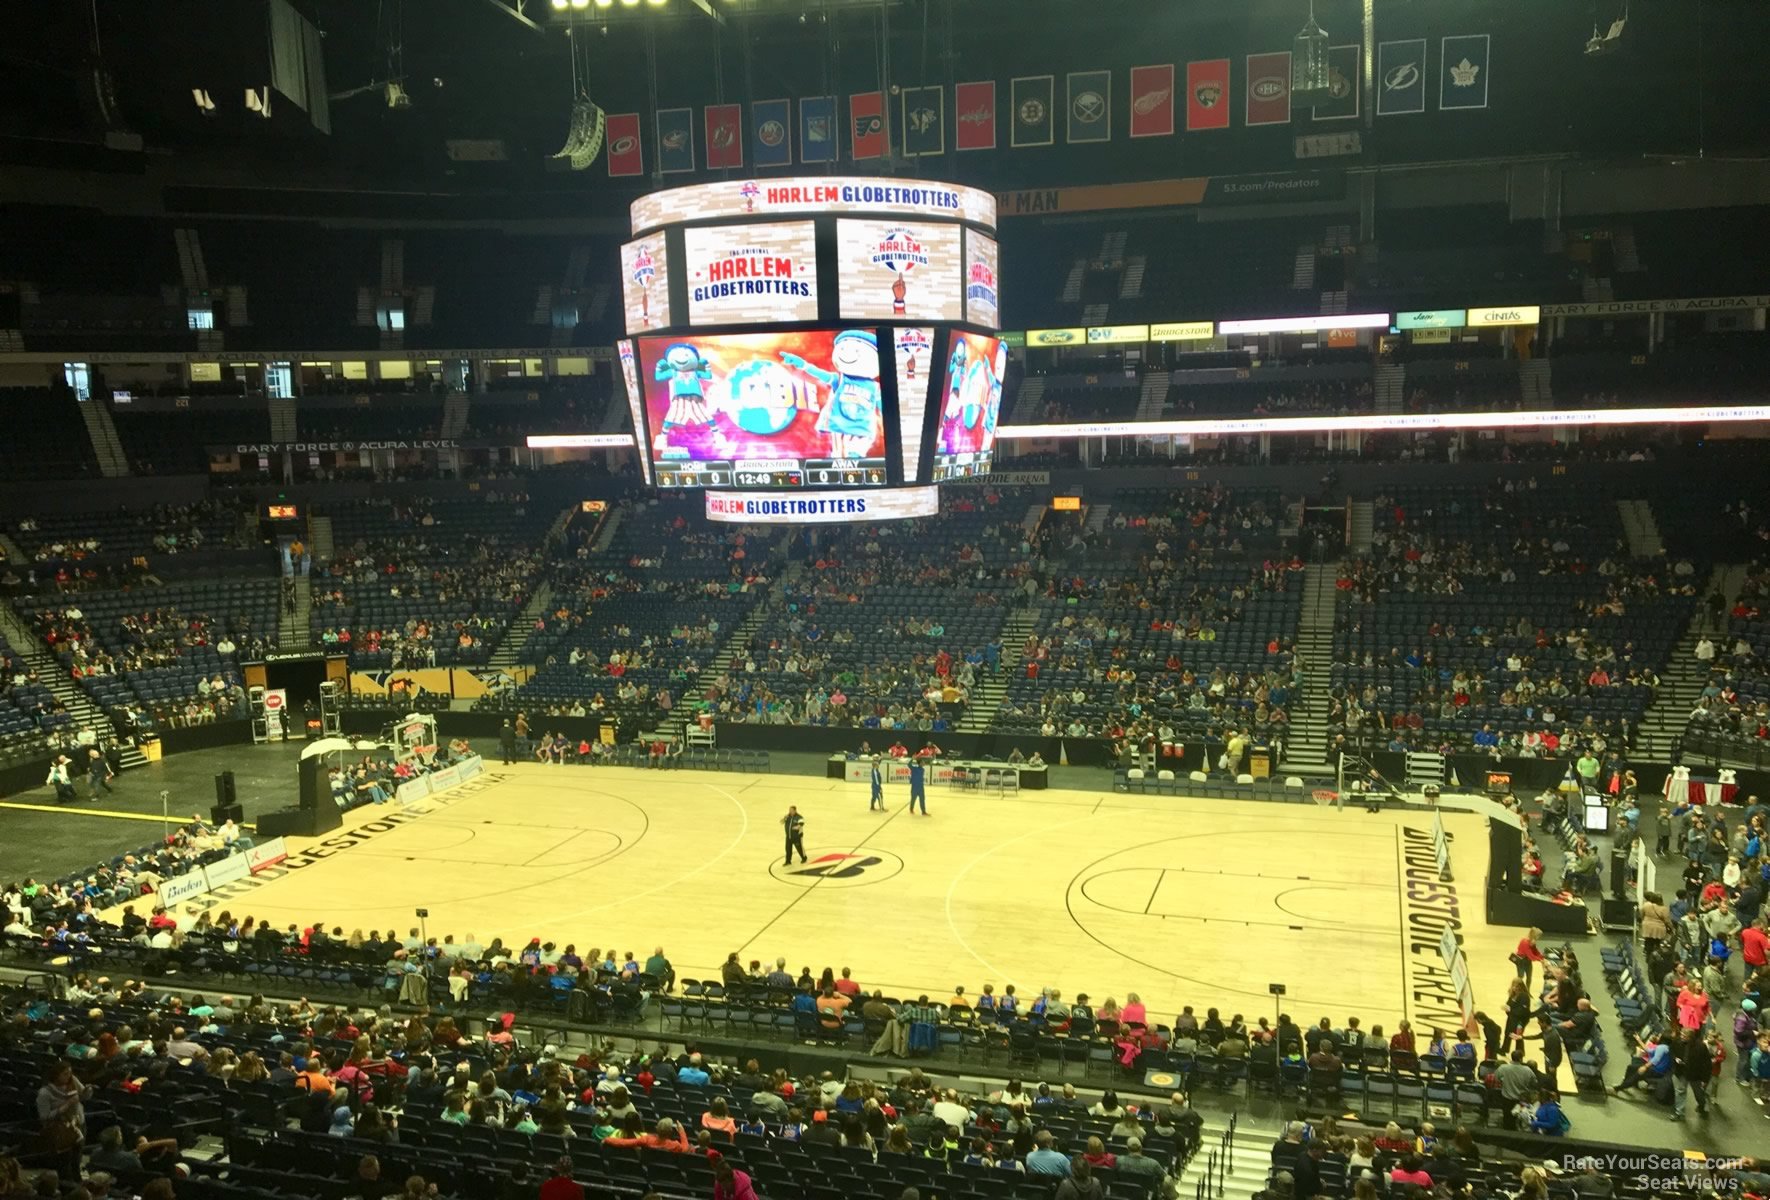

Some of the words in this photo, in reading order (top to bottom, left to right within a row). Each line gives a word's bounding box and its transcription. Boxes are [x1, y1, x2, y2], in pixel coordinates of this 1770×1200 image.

[767, 186, 839, 204] HARLEM
[842, 186, 959, 208] GLOBETROTTERS
[1016, 191, 1059, 213] MAN
[880, 241, 920, 253] HARLEM
[873, 253, 928, 265] GLOBETROTTERS
[708, 257, 792, 283] HARLEM
[1543, 306, 1586, 315] GARY
[1598, 302, 1658, 313] FORCE
[1685, 298, 1748, 309] ACURA
[1042, 333, 1069, 343] Ford
[1153, 327, 1211, 337] BRIDGESTONE
[237, 445, 279, 453] GARY
[286, 443, 339, 452] FORCE
[359, 442, 408, 450] ACURA
[413, 440, 459, 448] LEVEL
[832, 460, 859, 469] AWAY
[711, 472, 720, 484] 0
[738, 473, 771, 484] 12:49
[819, 470, 828, 483] 0
[1014, 474, 1046, 482] ARENA
[711, 500, 744, 513] HARLEM
[747, 499, 865, 514] GLOBETROTTERS
[431, 772, 516, 805] ARENA
[168, 879, 202, 900] Baden
